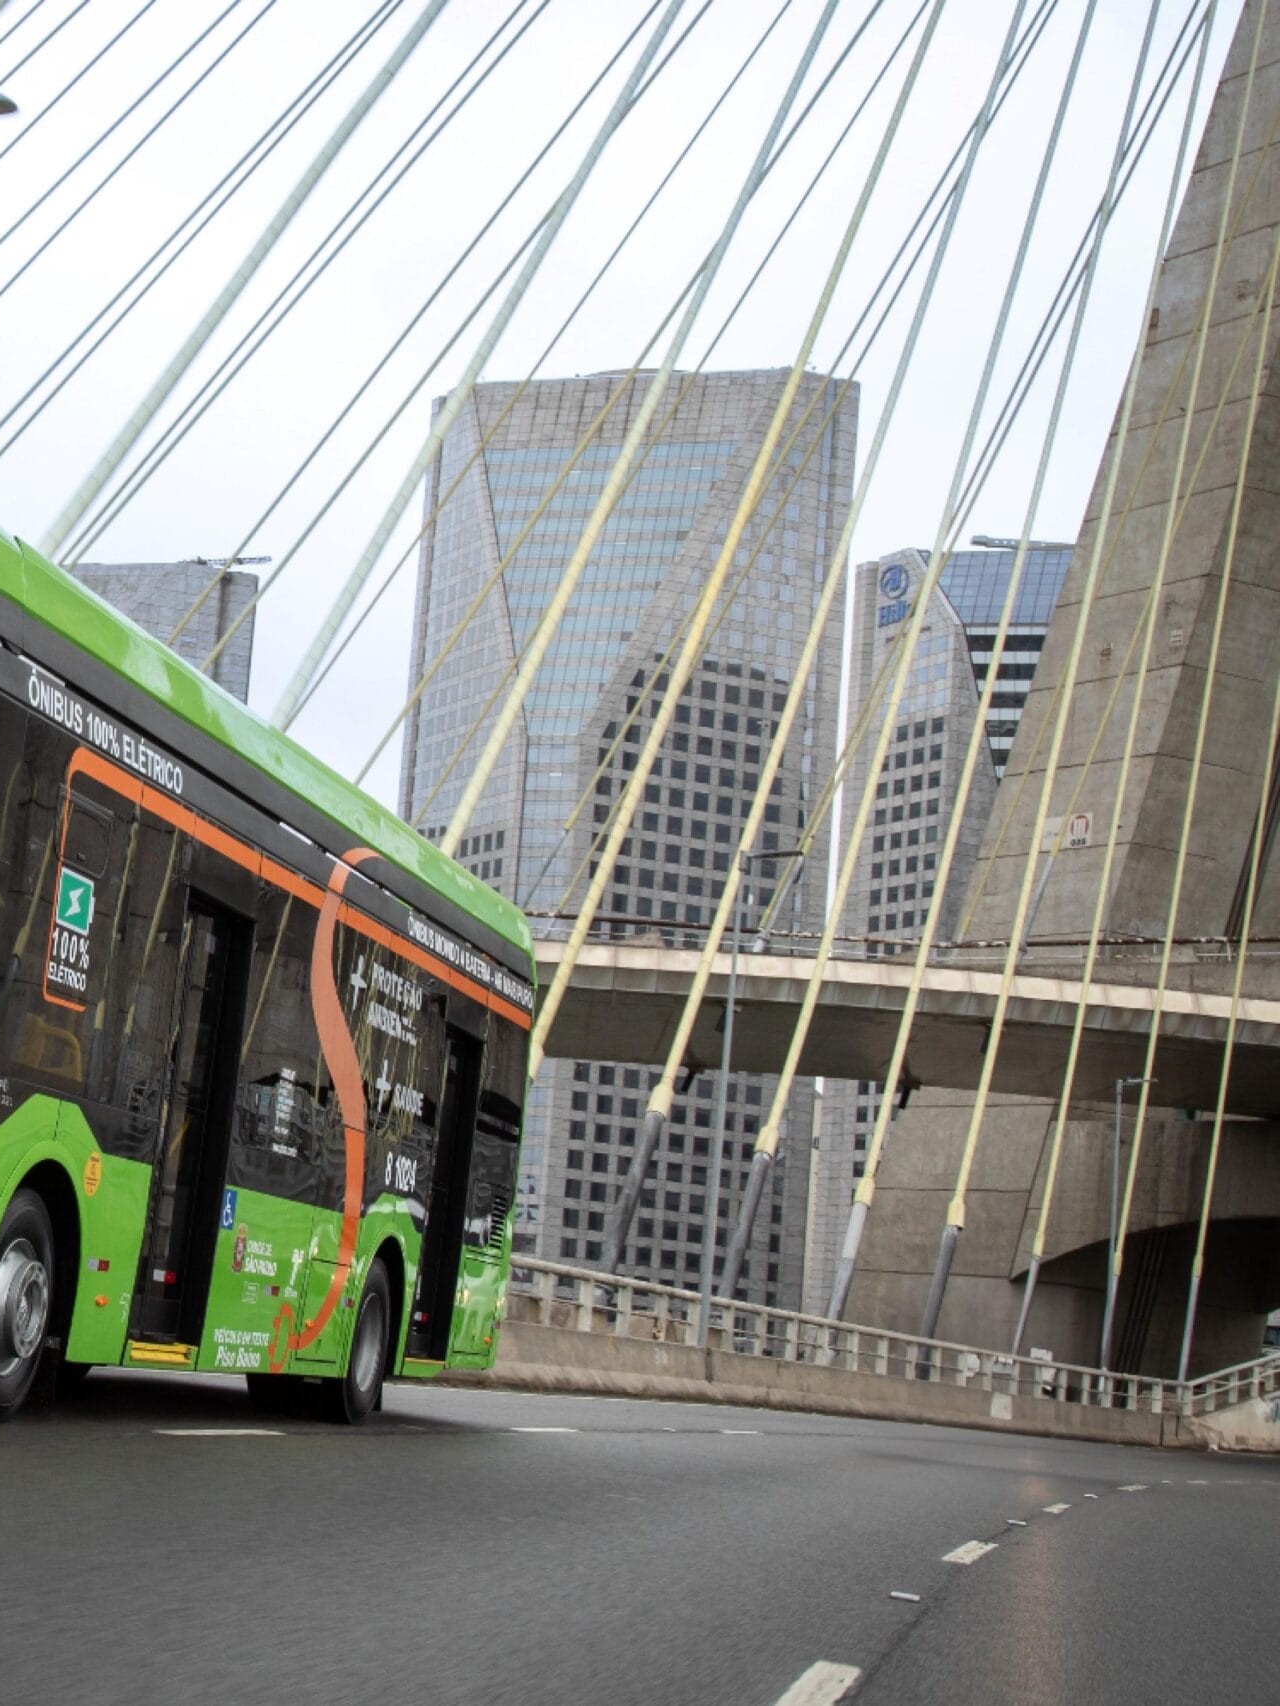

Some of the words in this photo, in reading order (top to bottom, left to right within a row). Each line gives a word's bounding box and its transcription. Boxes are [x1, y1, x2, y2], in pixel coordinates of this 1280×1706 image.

[28, 666, 83, 735] ÔNIBUS
[86, 712, 120, 758] 100%
[122, 738, 183, 794] ELÉTRICO
[52, 927, 90, 970] 100%
[47, 960, 87, 992] ELÉTRICO
[371, 962, 423, 1011] PROTEÇÃO
[385, 1151, 393, 1186] 8
[395, 1154, 417, 1193] 1024
